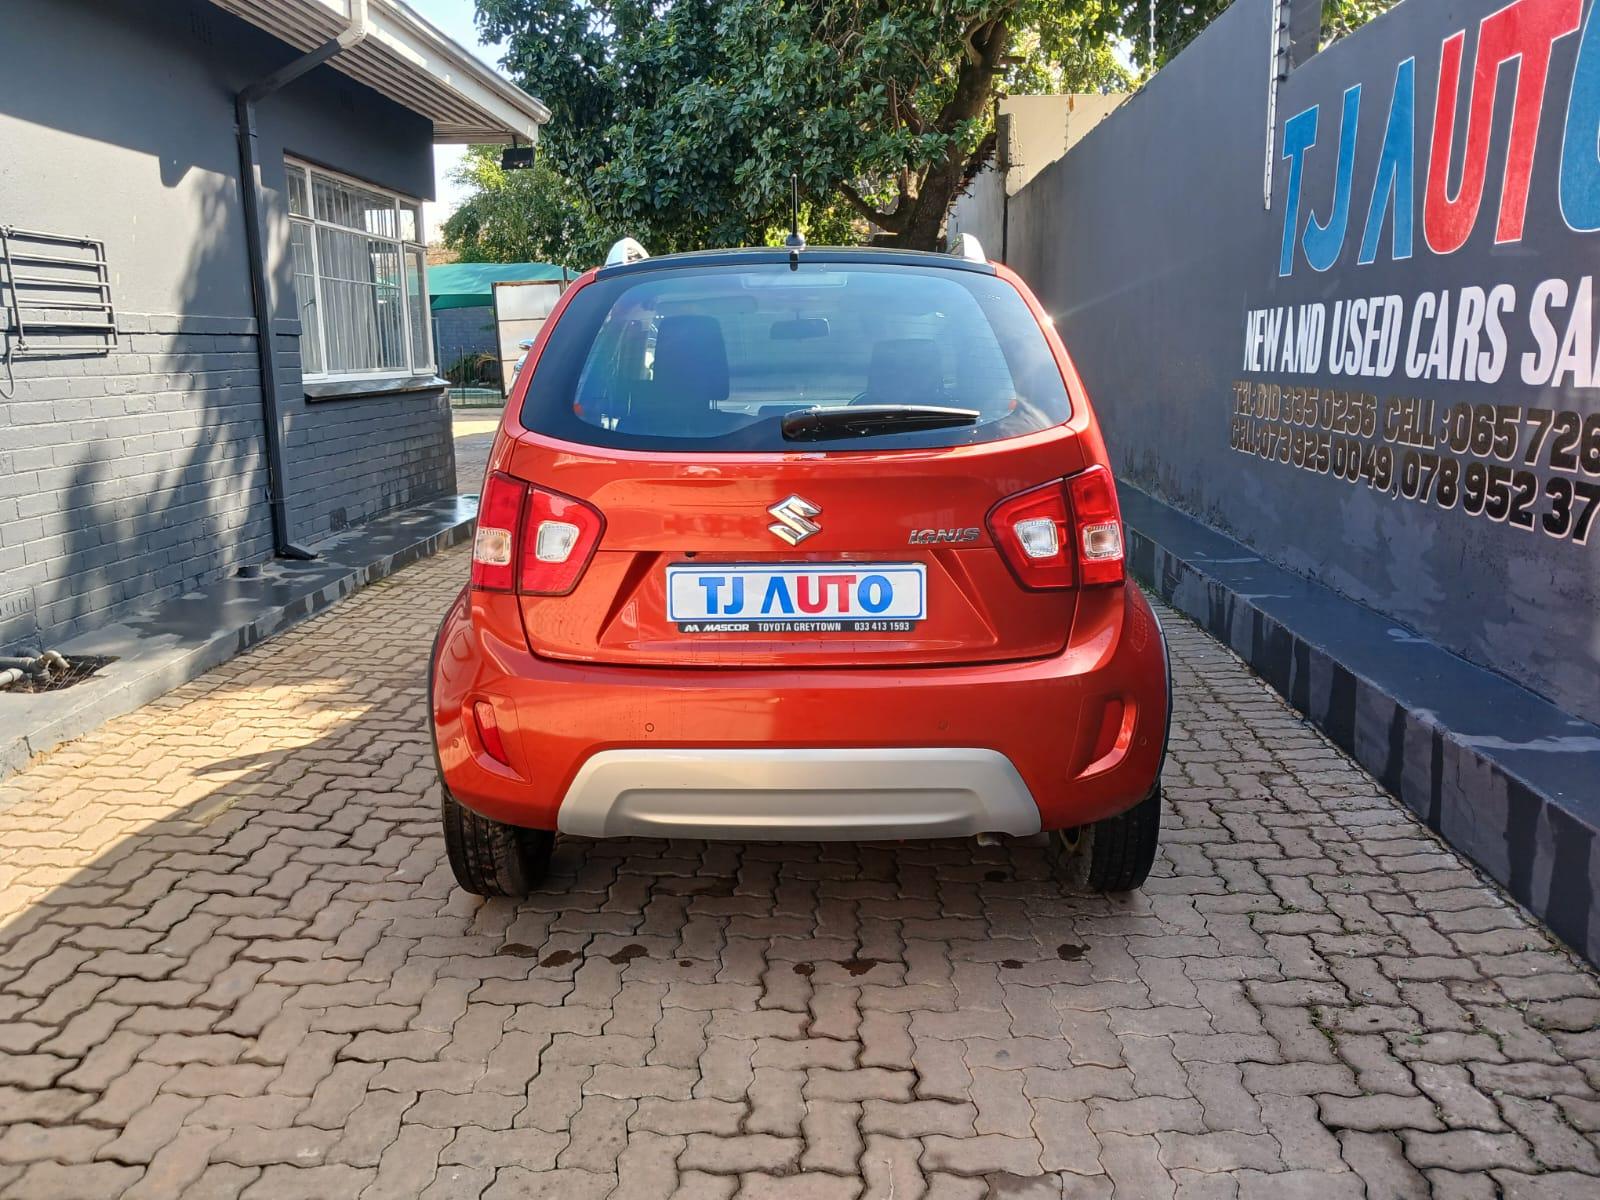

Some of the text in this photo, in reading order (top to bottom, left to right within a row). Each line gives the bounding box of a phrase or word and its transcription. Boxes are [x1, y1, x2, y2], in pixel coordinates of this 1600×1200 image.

[1279, 83, 1362, 277] TJ
[1243, 306, 1284, 372] NEW
[1280, 302, 1326, 374] AND
[1328, 294, 1403, 377] USED
[1405, 283, 1516, 384] CARS
[1320, 388, 1377, 439] 0256
[1293, 428, 1332, 475] 925
[1463, 461, 1538, 532] 952
[1542, 476, 1600, 546] 37
[908, 527, 980, 544] IGNIS
[699, 574, 893, 614] TJ AUTO
[702, 620, 910, 632] MASCOR TOYOTA GREYTOWN 033 413 1593
